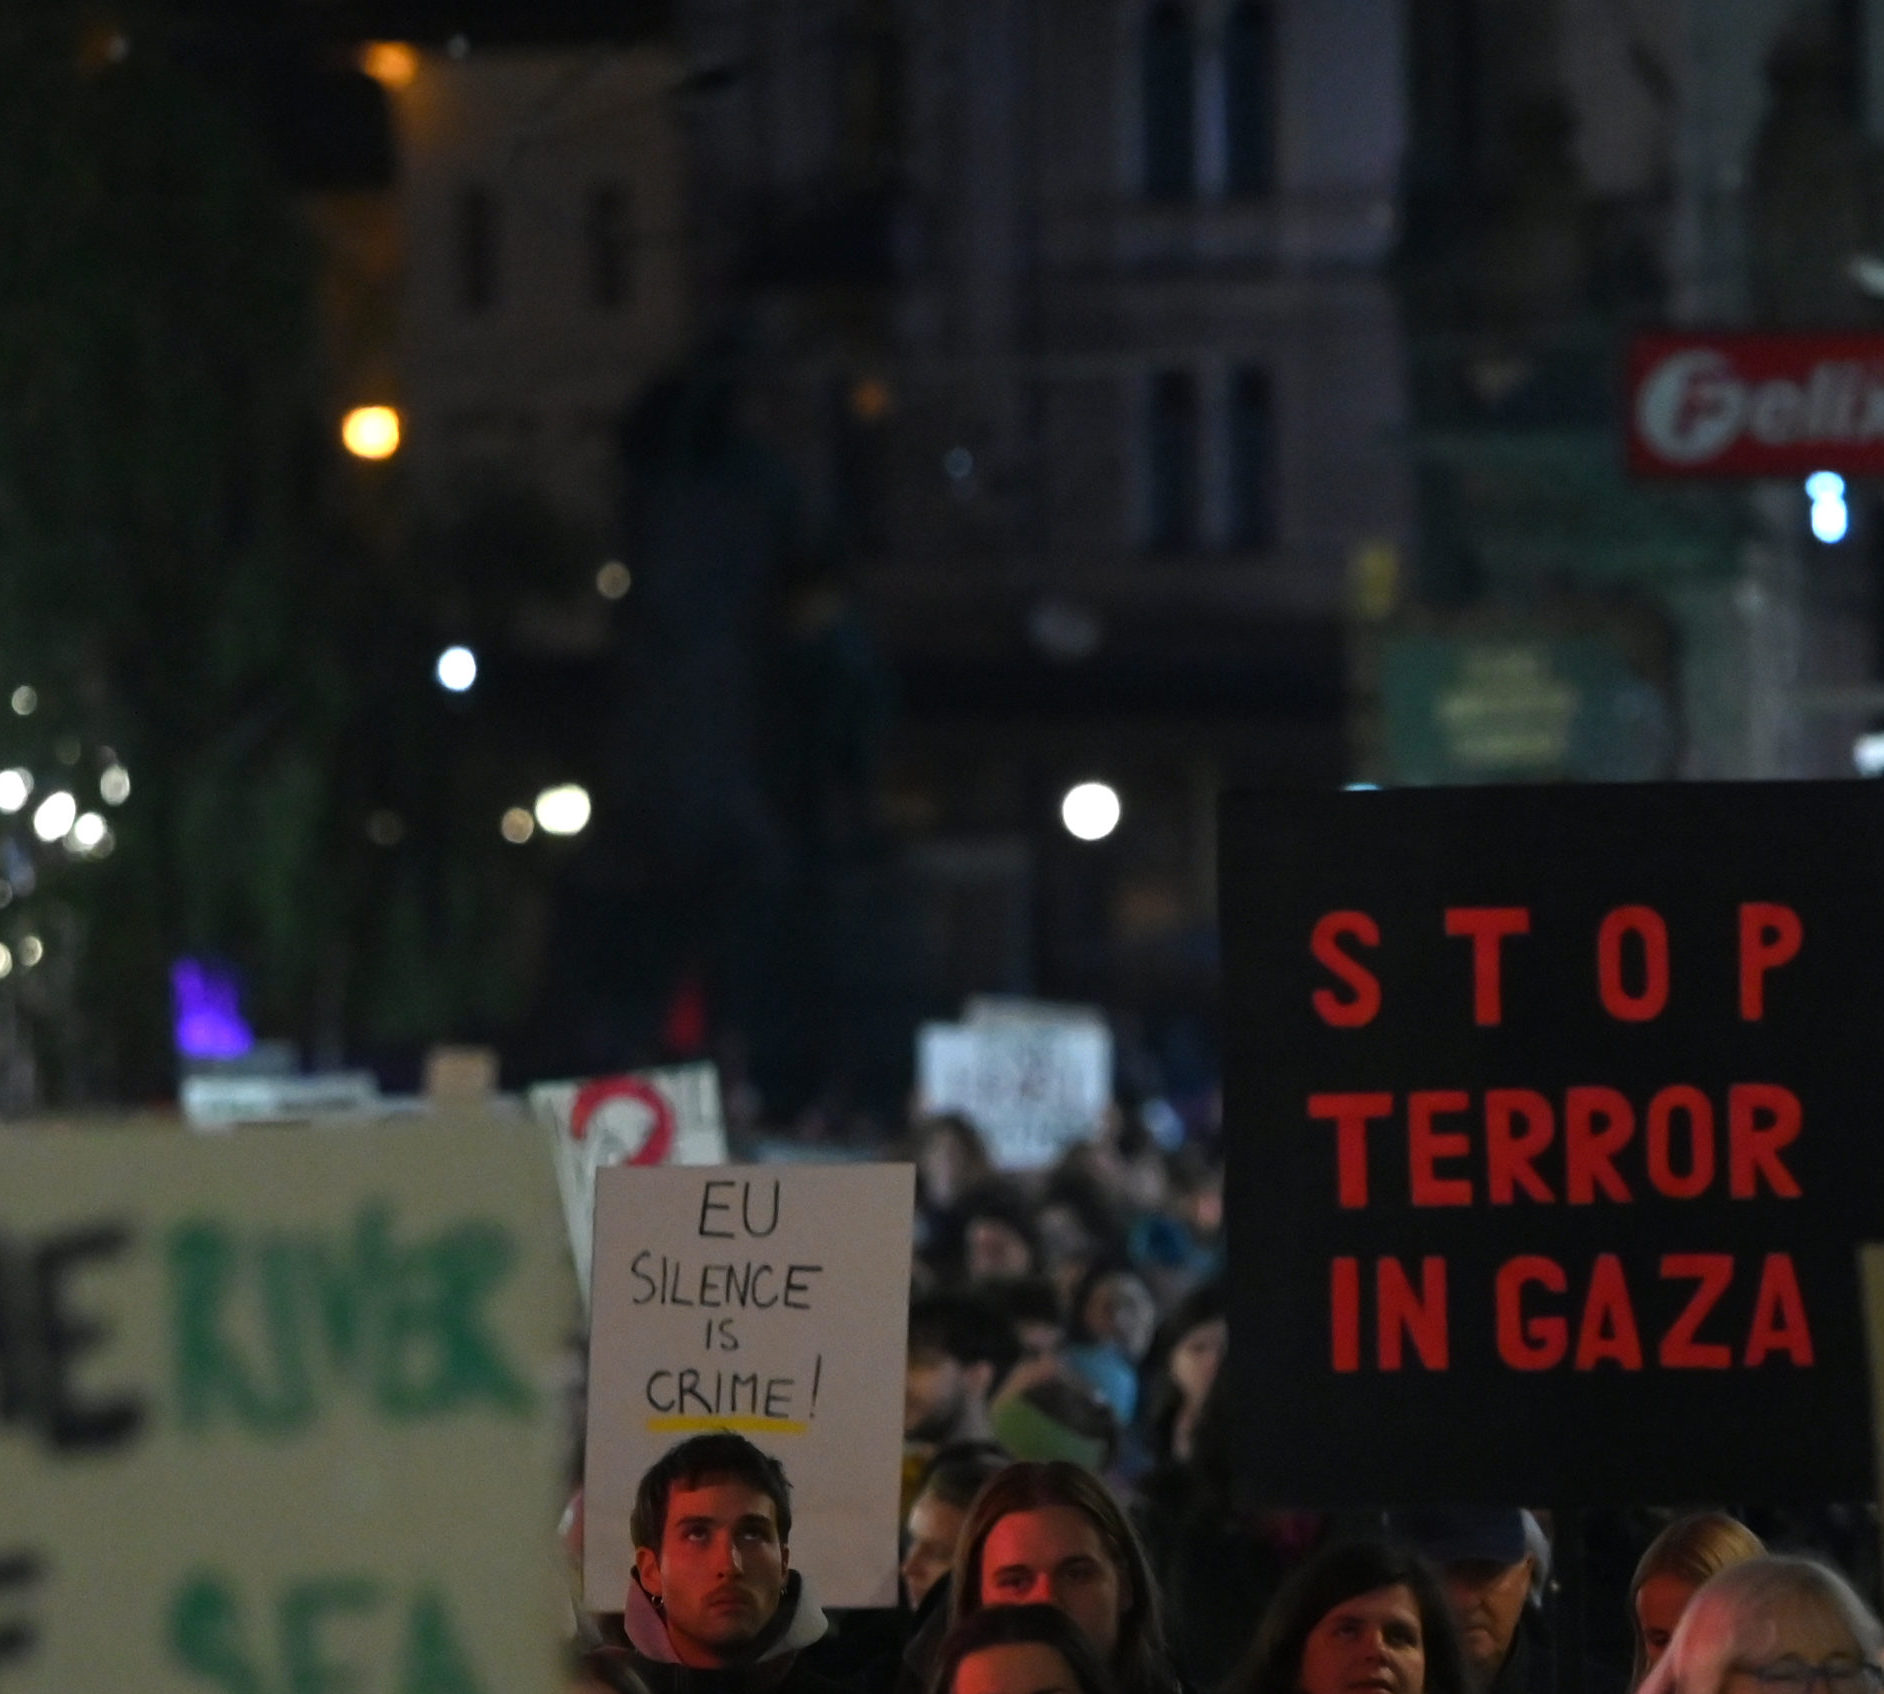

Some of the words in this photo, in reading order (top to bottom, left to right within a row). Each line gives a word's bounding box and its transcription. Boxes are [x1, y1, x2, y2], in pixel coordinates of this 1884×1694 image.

[1308, 902, 1805, 1029] STOP
[1307, 1083, 1805, 1208] TERROR
[698, 1180, 781, 1240] EU
[162, 1202, 543, 1436] RIVER
[630, 1250, 824, 1310] SILENCE
[1328, 1254, 1449, 1373] IN
[1493, 1252, 1815, 1373] GAZA
[704, 1317, 740, 1352] IS
[645, 1353, 823, 1420] CRIME!
